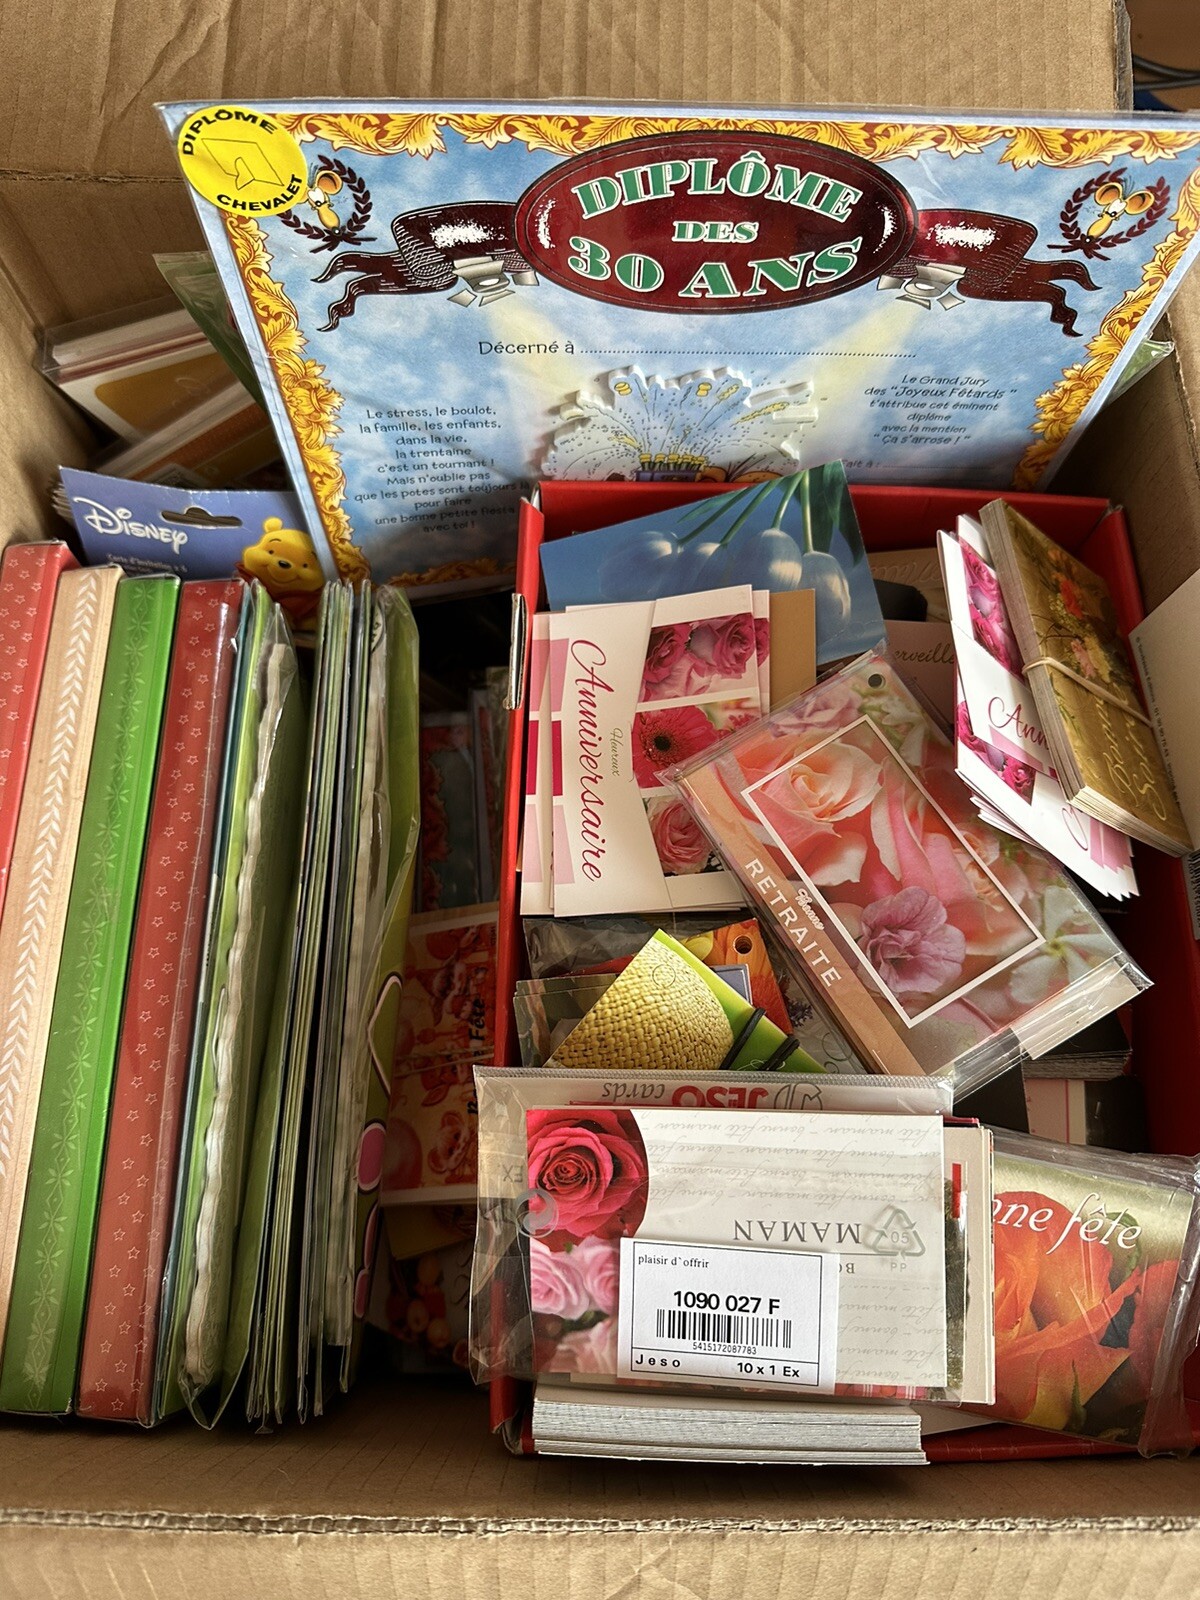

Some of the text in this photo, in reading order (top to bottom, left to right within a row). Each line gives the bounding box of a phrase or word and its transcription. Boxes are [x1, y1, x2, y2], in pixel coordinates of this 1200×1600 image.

[217, 174, 302, 212] CHEVALET
[571, 150, 863, 222] DIPLÔME
[672, 220, 759, 243] DES
[567, 236, 863, 299] 30 ANS
[479, 340, 574, 355] Décerné à
[902, 375, 990, 387] Le Grand Jury
[864, 387, 887, 396] des
[367, 409, 383, 419] Le
[436, 407, 447, 416] le
[870, 400, 998, 411] t'attribue cet éminent
[360, 424, 371, 433] la
[425, 421, 443, 430] les
[882, 424, 966, 434] avec la mention
[396, 436, 426, 445] dans
[431, 435, 442, 444] la
[396, 448, 471, 459] la trentaine
[377, 464, 409, 473] c'est
[413, 463, 428, 471] un
[432, 461, 487, 470] tournant
[387, 476, 415, 485] Mais
[470, 472, 490, 481] pas
[355, 491, 377, 503] que
[381, 490, 398, 499] les
[401, 487, 435, 499] potes
[439, 485, 464, 495] sont
[610, 727, 624, 777] Heureux
[570, 639, 615, 882] Anniversaire
[745, 858, 841, 987] RETRAITE
[602, 1082, 665, 1099] cards
[734, 1219, 862, 1244] MAMAN
[1046, 1192, 1142, 1255] fête
[638, 1255, 668, 1266] plaisir
[673, 1291, 780, 1314] 1090 027 F
[693, 1342, 757, 1355] 5415172087783
[635, 1354, 800, 1378] Jeso 10 x 1 Ex
